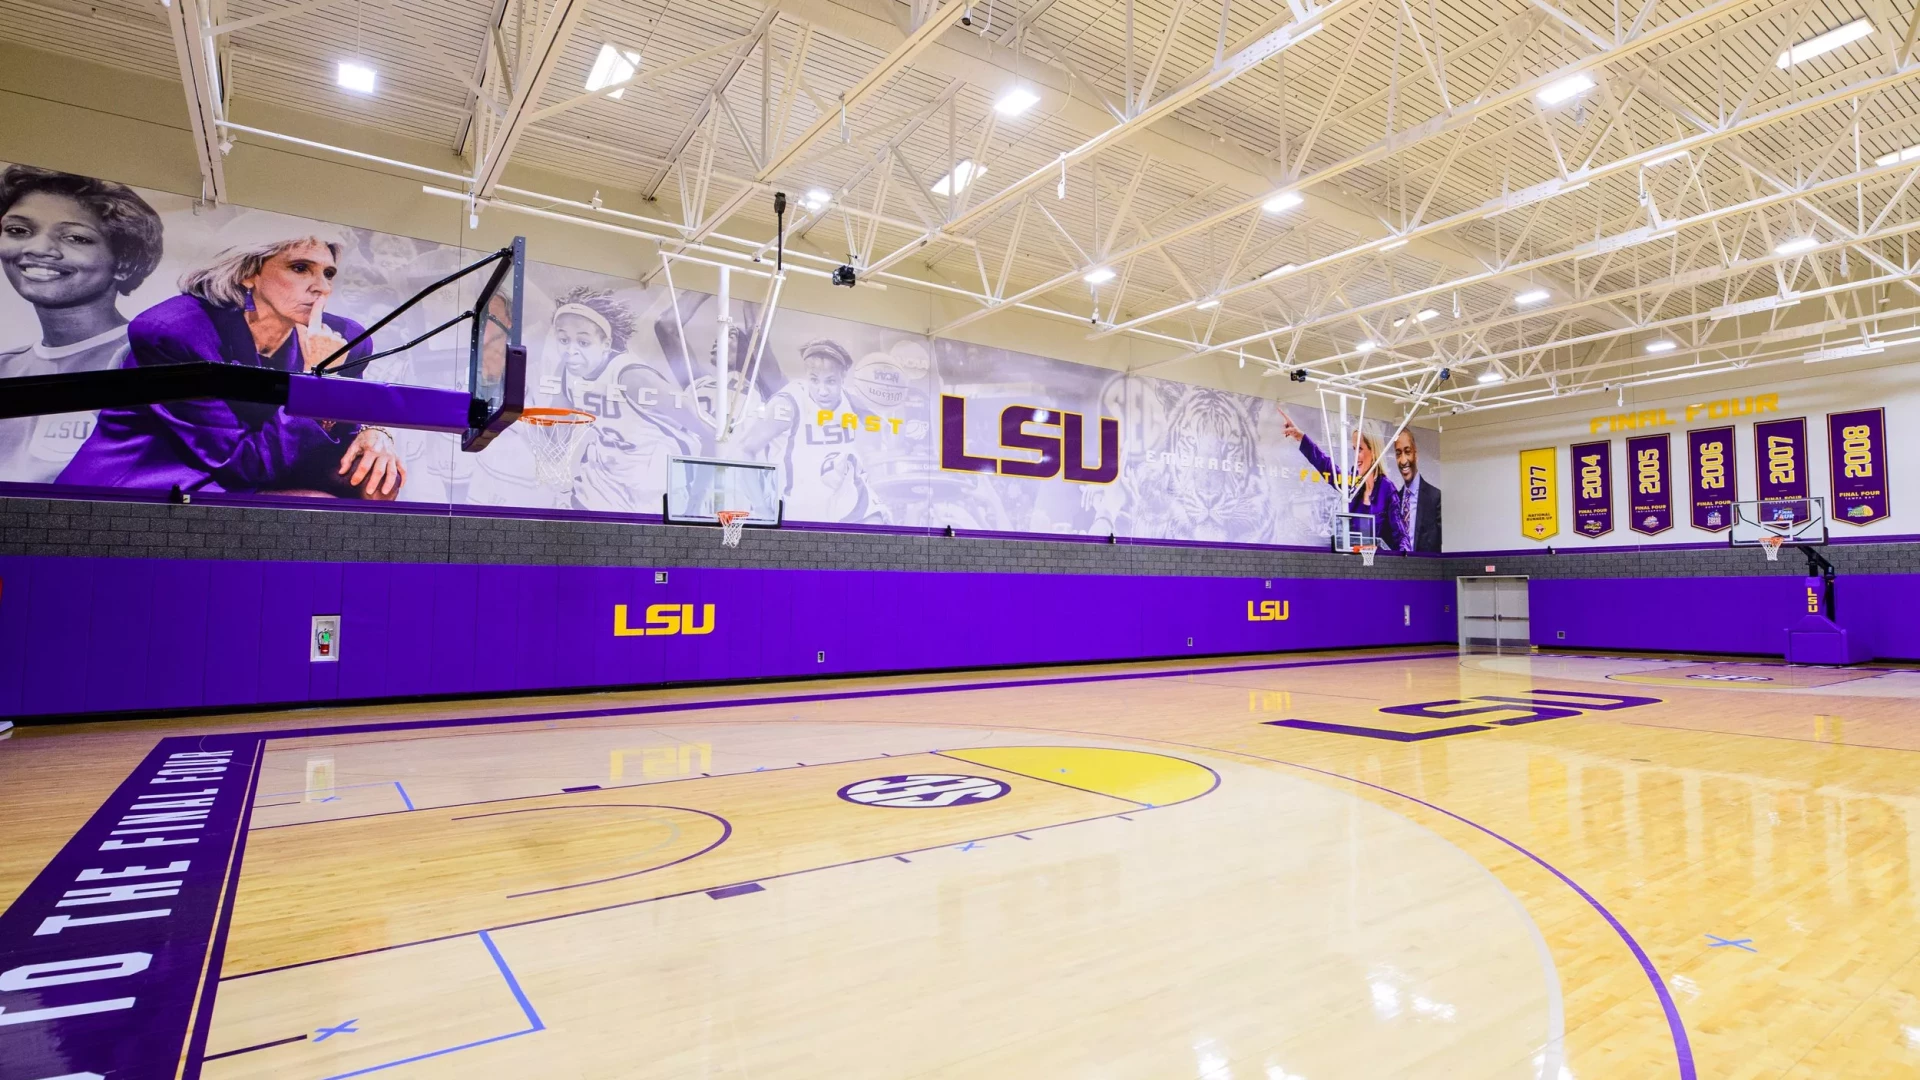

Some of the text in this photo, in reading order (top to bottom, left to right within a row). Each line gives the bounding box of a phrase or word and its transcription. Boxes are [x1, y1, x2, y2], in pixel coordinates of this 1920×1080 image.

[44, 421, 90, 440] LSU
[817, 409, 903, 435] PAST
[1589, 392, 1779, 434] FINAL FOUR
[940, 394, 1119, 486] LSU
[1767, 435, 1795, 484] 2007
[1842, 424, 1872, 478] 2008
[1145, 450, 1244, 474] EMBRACE
[1256, 463, 1290, 479] THE
[1530, 466, 1547, 501] 1977
[1581, 454, 1602, 499] 2004
[1638, 448, 1661, 494] 2005
[1700, 441, 1725, 489] 2006
[613, 603, 715, 637] LSU
[1247, 599, 1289, 622] LSU
[1807, 587, 1818, 613] LSU
[1260, 689, 1663, 742] LSU
[150, 749, 234, 784] FOUR
[98, 788, 219, 851] FINAL
[33, 860, 191, 936] THE
